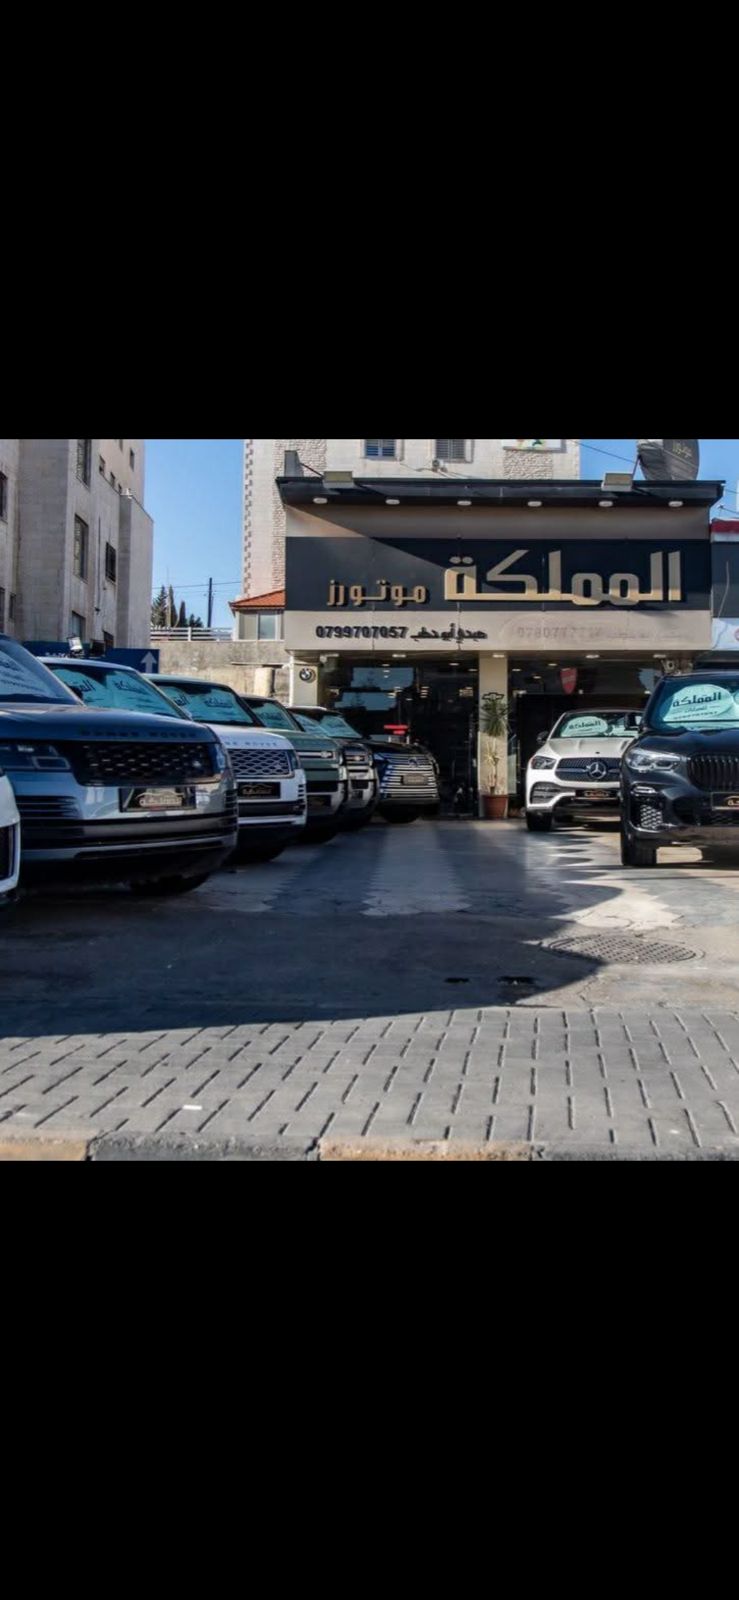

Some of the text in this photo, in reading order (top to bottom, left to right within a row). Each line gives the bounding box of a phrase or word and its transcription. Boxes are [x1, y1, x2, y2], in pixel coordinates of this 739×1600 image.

[327, 549, 682, 607] المملكة موتورز
[315, 625, 408, 639] 0799707057
[672, 692, 722, 707] المملكة
